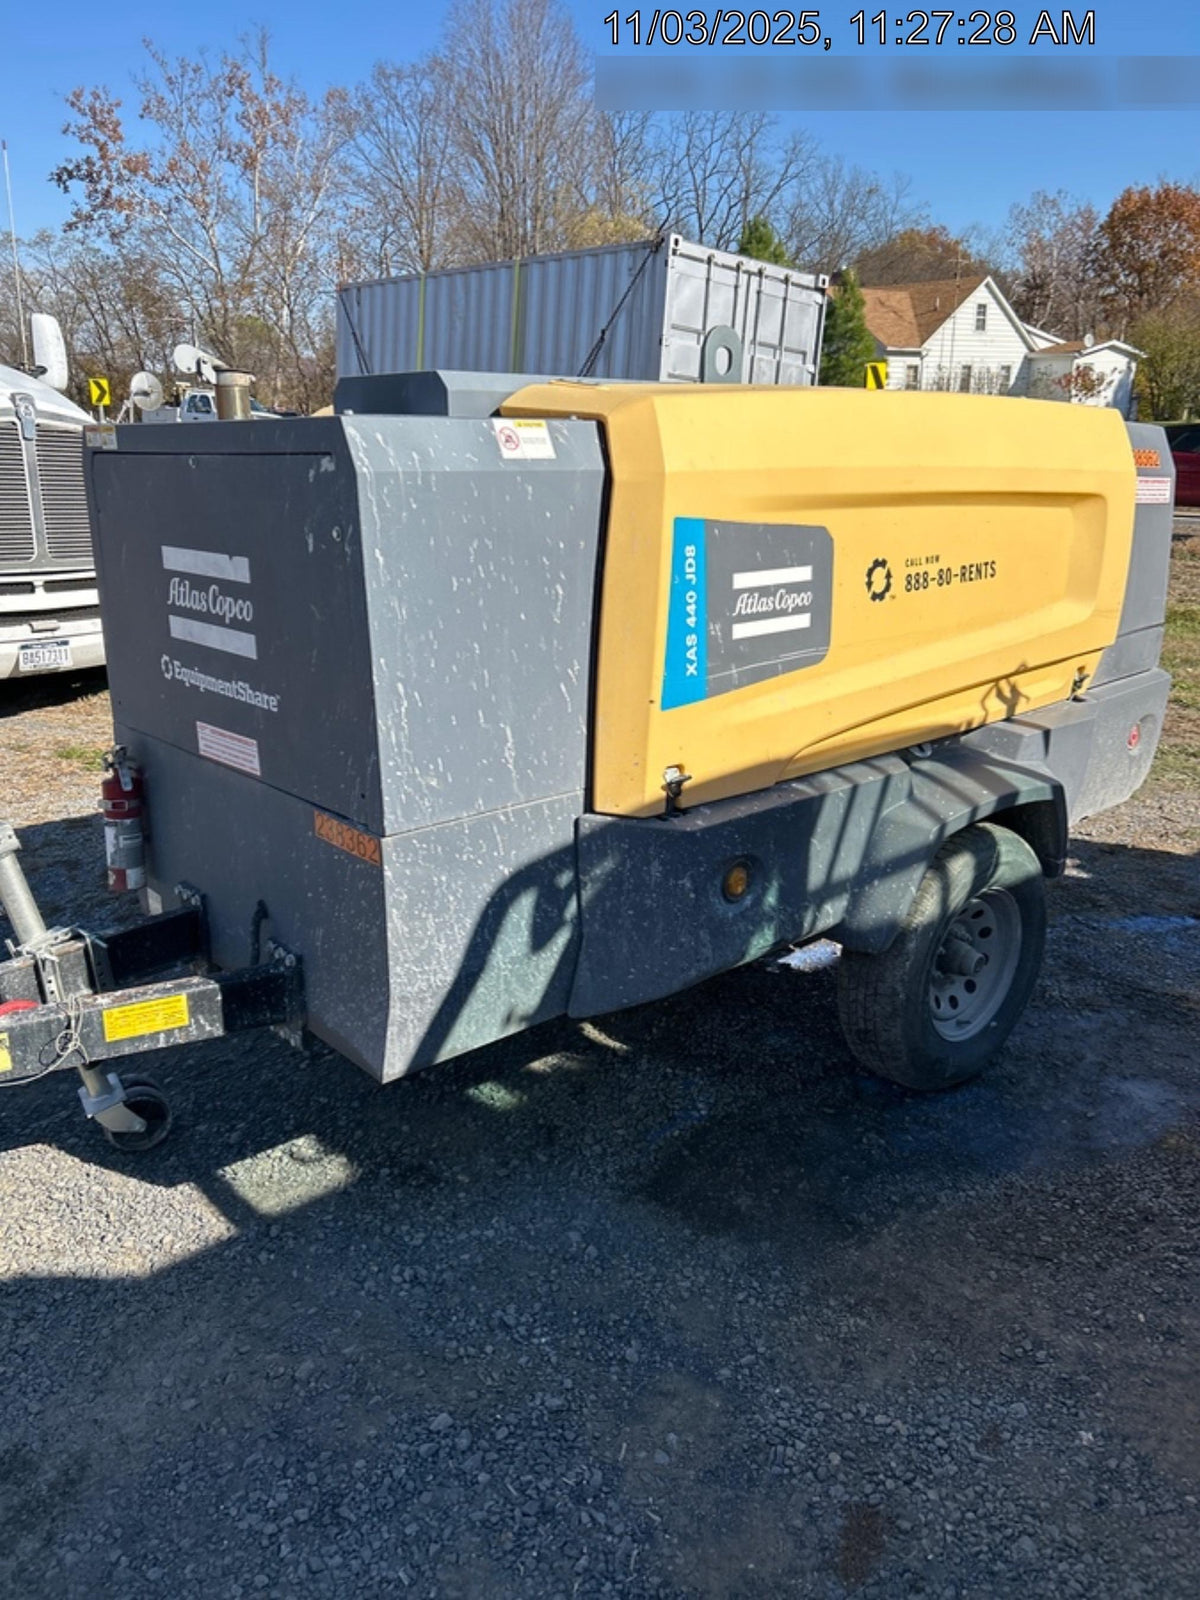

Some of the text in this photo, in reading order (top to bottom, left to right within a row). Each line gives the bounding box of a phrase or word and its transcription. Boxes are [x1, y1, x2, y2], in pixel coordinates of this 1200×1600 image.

[905, 558, 923, 568] CALL
[905, 560, 996, 593] 888-80-RENTS
[684, 544, 698, 677] XAS 440 JD8
[173, 660, 279, 712] EquipmentShare
